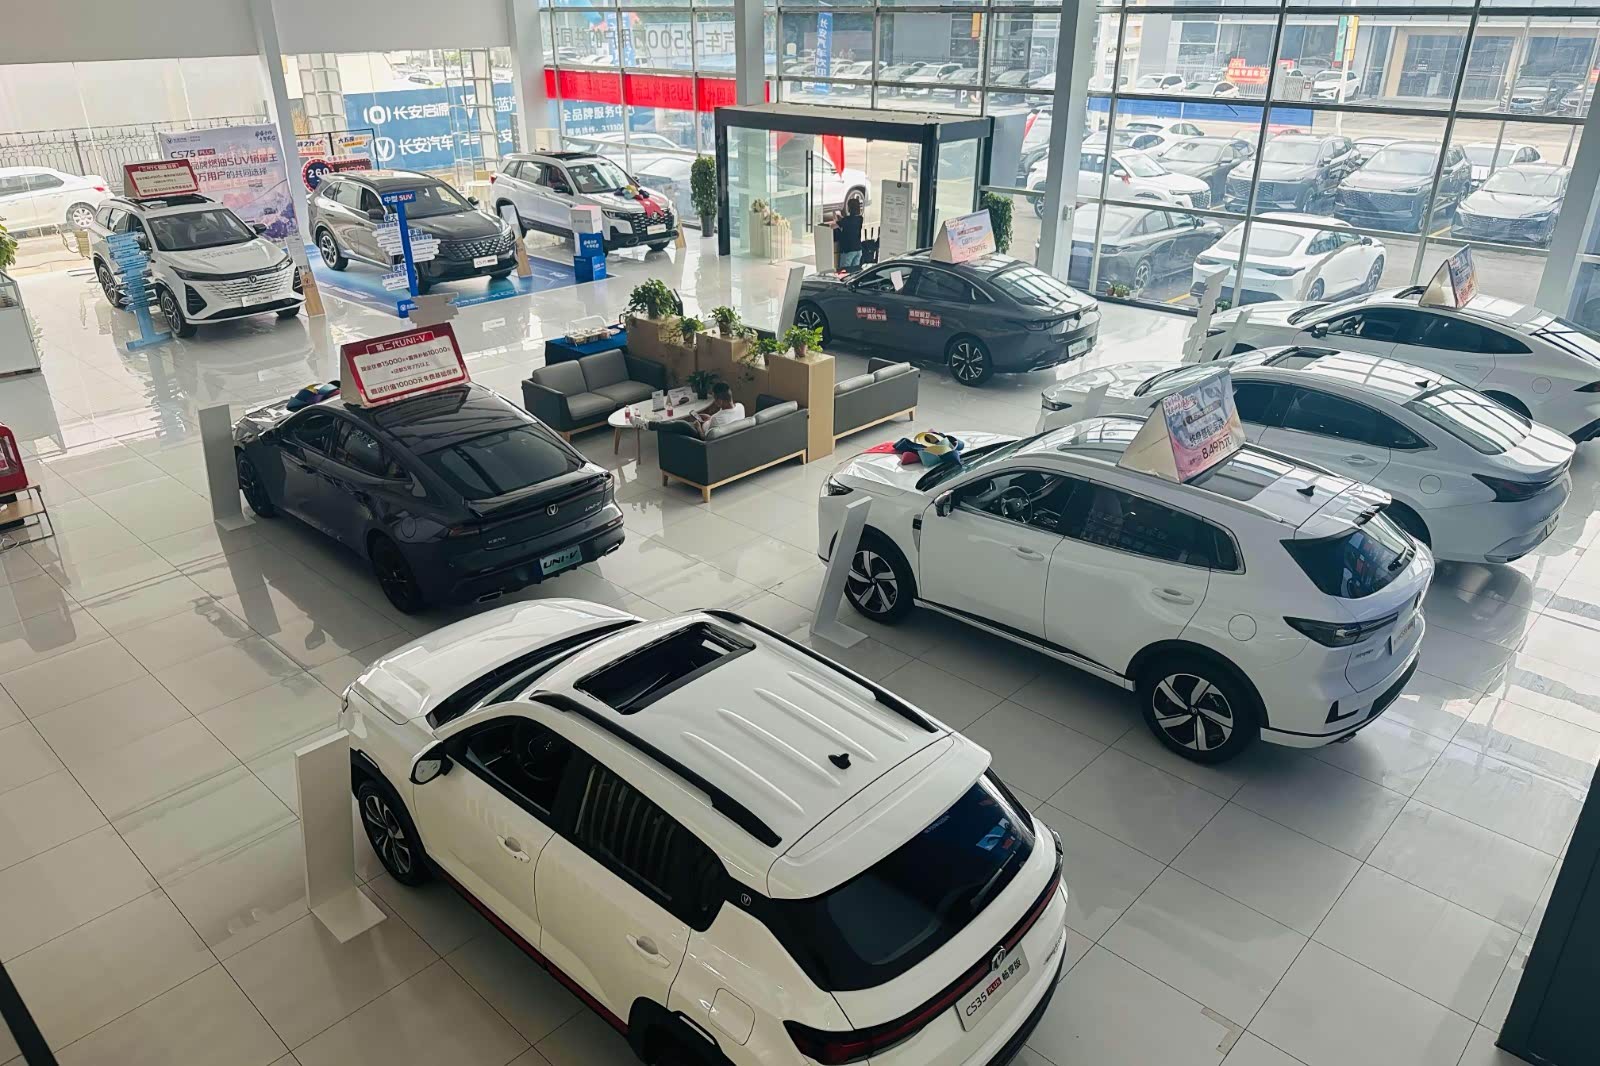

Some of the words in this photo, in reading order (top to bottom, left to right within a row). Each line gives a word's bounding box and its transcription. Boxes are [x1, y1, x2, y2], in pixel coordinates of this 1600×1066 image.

[393, 102, 450, 120] 长安启源
[170, 149, 196, 159] CS75
[398, 135, 454, 155] 长安汽车
[375, 335, 425, 352] 第二代UNI-V
[543, 550, 578, 569] UNI-V
[966, 992, 987, 1016] CS35
[987, 978, 1002, 995] PLUS
